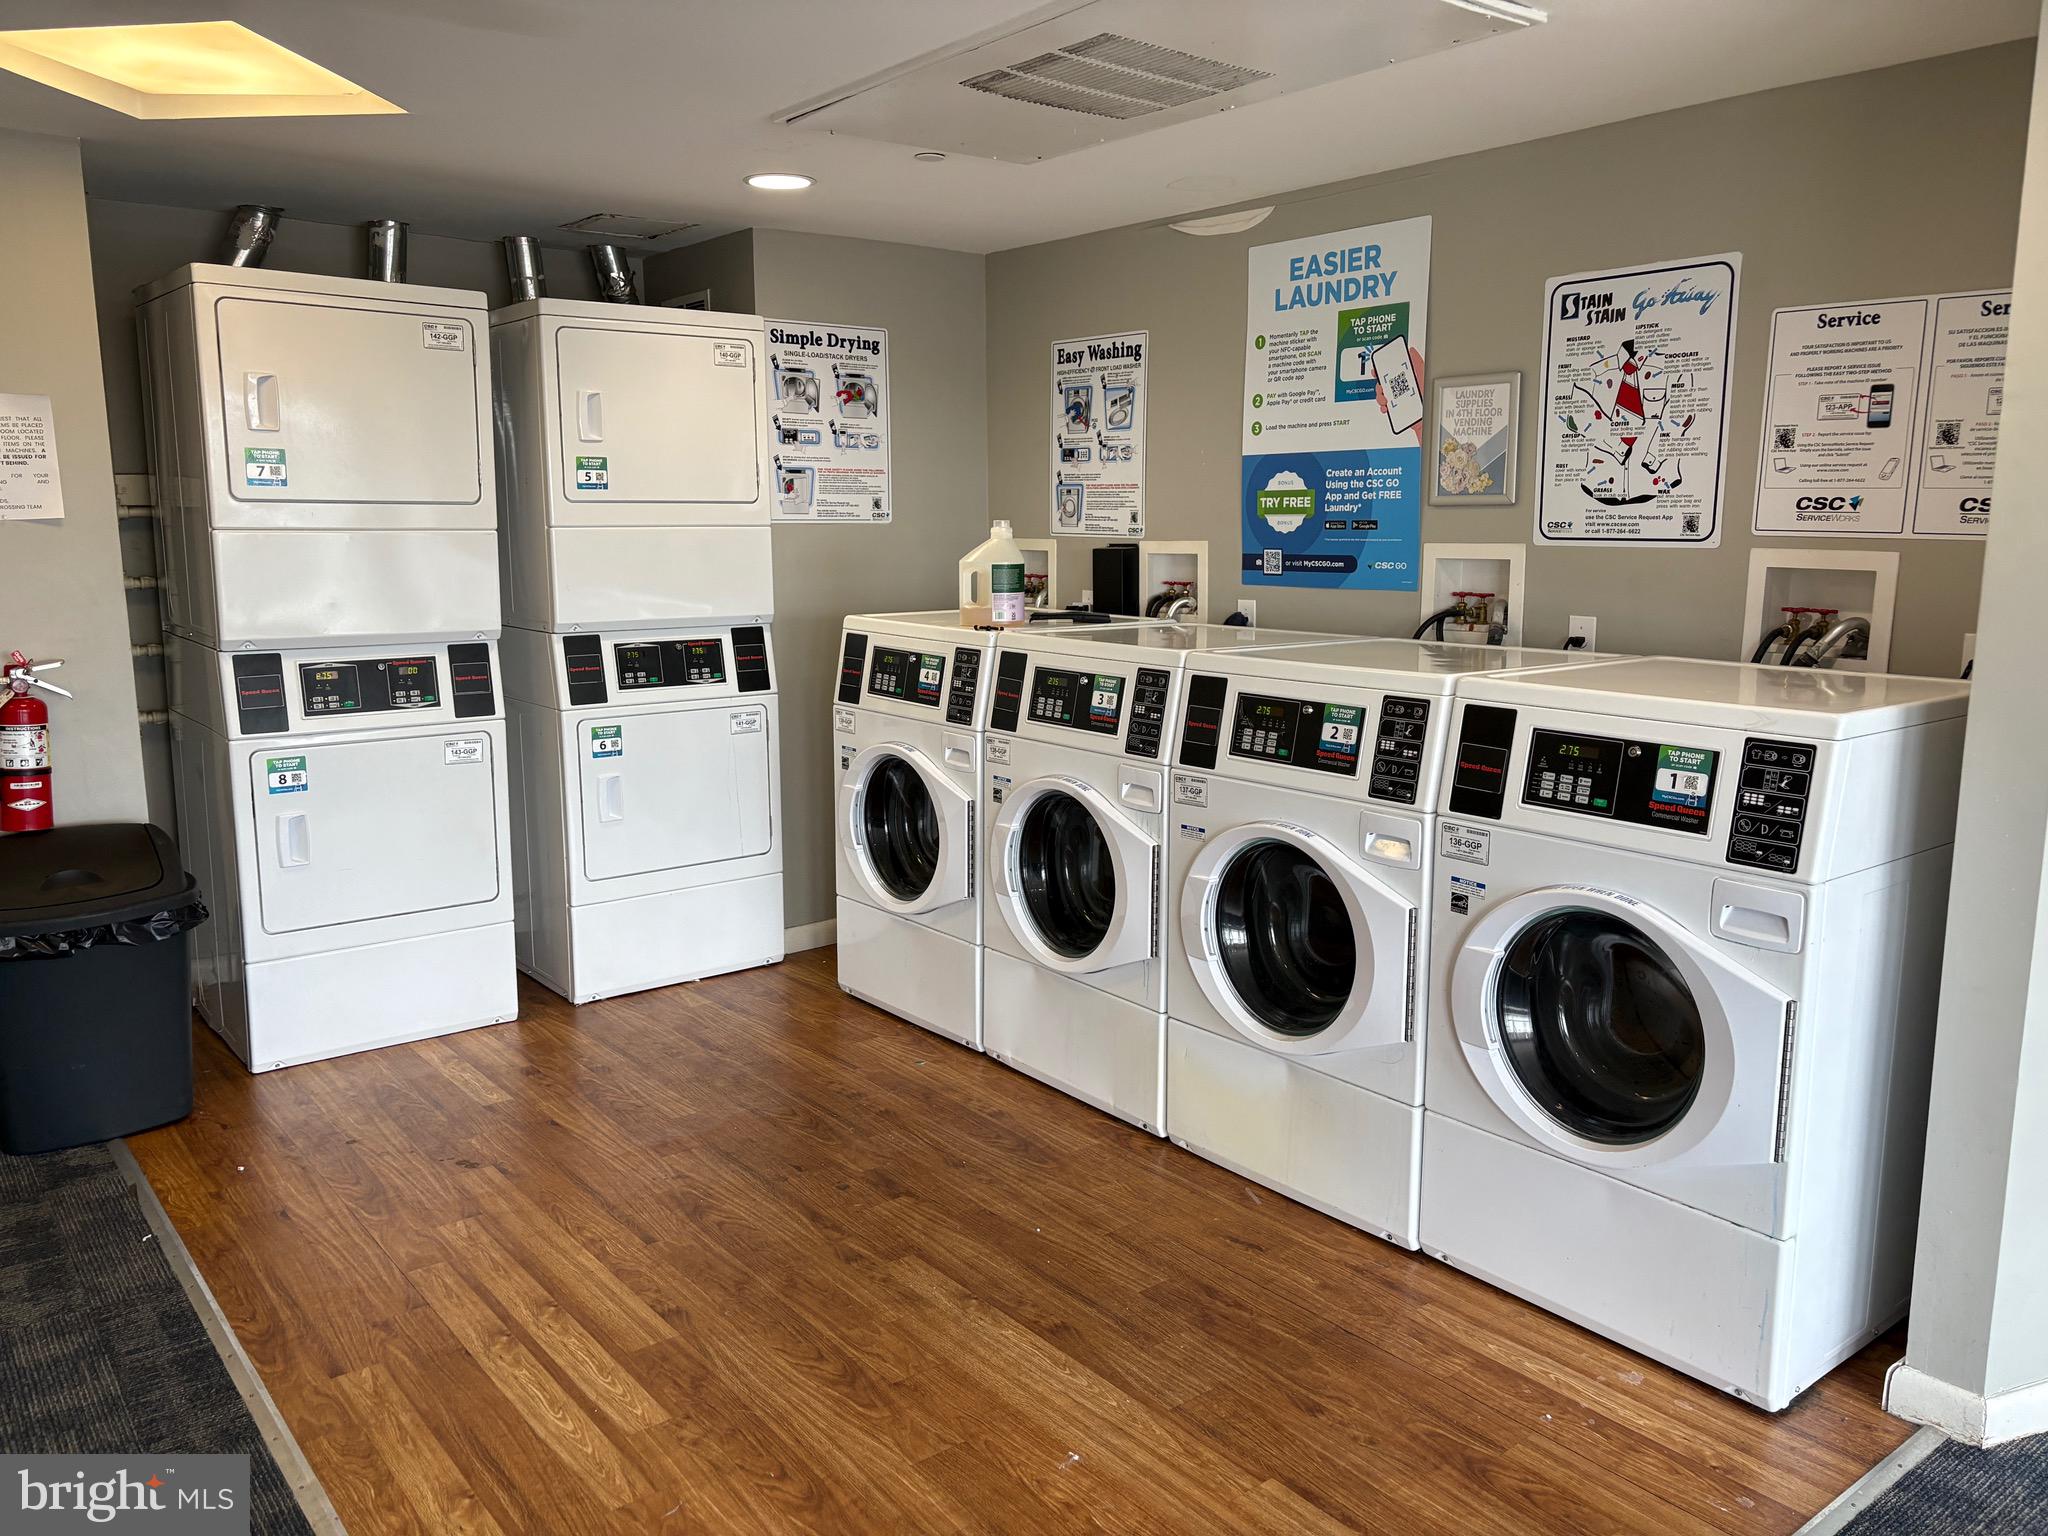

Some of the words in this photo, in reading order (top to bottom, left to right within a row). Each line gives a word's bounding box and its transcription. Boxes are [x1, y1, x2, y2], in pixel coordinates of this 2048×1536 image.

[1290, 245, 1381, 281] EASIER
[1275, 271, 1398, 311] LAUNDRY
[1560, 292, 1613, 320] STAIN
[1632, 288, 1660, 320] Go
[1661, 278, 1720, 315] Away
[1350, 317, 1366, 327] TAP
[1367, 313, 1397, 325] PHONE
[1585, 307, 1626, 327] STAIN
[1817, 311, 1881, 329] Service
[1354, 326, 1364, 335] TO
[1366, 323, 1392, 334] START
[1635, 322, 1659, 330] LIPSTICK
[430, 333, 458, 341] 142-GGP
[1270, 331, 1298, 340] Momentarily
[770, 328, 823, 350] Simple
[827, 333, 880, 355] Drying
[845, 354, 868, 362] DRYERS
[1057, 348, 1085, 367] Easy
[1087, 341, 1142, 361] Washing
[1664, 351, 1699, 359] CHOCOLATE
[1358, 351, 1366, 375] 1
[1057, 367, 1089, 376] HIGH-EFFICIENCY
[1279, 367, 1307, 375] smartphone
[1289, 390, 1307, 398] Google
[1456, 389, 1495, 399] LAUNDRY
[1255, 397, 1261, 406] 2
[1300, 396, 1314, 404] credit
[1456, 399, 1493, 408] SUPPLIES
[1825, 403, 1853, 411] 123-APP
[1446, 409, 1455, 418] IN
[1457, 408, 1473, 417] 4TH
[1475, 407, 1503, 417] FLOOR
[1454, 417, 1493, 427] VENDING
[1254, 424, 1260, 434] 3
[1453, 426, 1493, 436] MACHINE
[256, 466, 265, 476] 7
[1326, 468, 1352, 477] Create
[1367, 467, 1402, 476] Account
[585, 472, 592, 482] 5
[1325, 480, 1348, 490] Using
[1350, 479, 1364, 488] the
[1366, 479, 1383, 488] CSC
[1386, 478, 1399, 487] GO
[1325, 492, 1342, 502] App
[1344, 491, 1360, 500] and
[1361, 491, 1377, 499] Get
[1378, 490, 1402, 499] FREE
[1260, 497, 1280, 508] TRY
[1283, 496, 1311, 508] FREE
[1796, 496, 1846, 511] CSC
[1959, 497, 1991, 512] CS
[1303, 560, 1344, 568] MyCSCGO.com
[1395, 562, 1407, 570] GO
[924, 671, 929, 680] 4
[1097, 694, 1104, 705] 3
[1330, 726, 1339, 739] 2
[600, 741, 606, 750] 6
[1559, 745, 1579, 756] 2.75
[451, 748, 478, 756] 143-GGP
[1681, 751, 1705, 760] PHONE
[1680, 757, 1701, 765] START
[1460, 761, 1481, 770] Speed
[1481, 764, 1501, 774] Queen
[279, 774, 287, 785] 8
[1670, 773, 1678, 789] 1
[1180, 786, 1202, 795] 137-GGP
[1648, 801, 1676, 811] Speed
[1677, 805, 1705, 817] Queen
[1651, 811, 1680, 821] Commercial
[1681, 815, 1699, 824] Washer
[1449, 837, 1482, 850] 136-GGP
